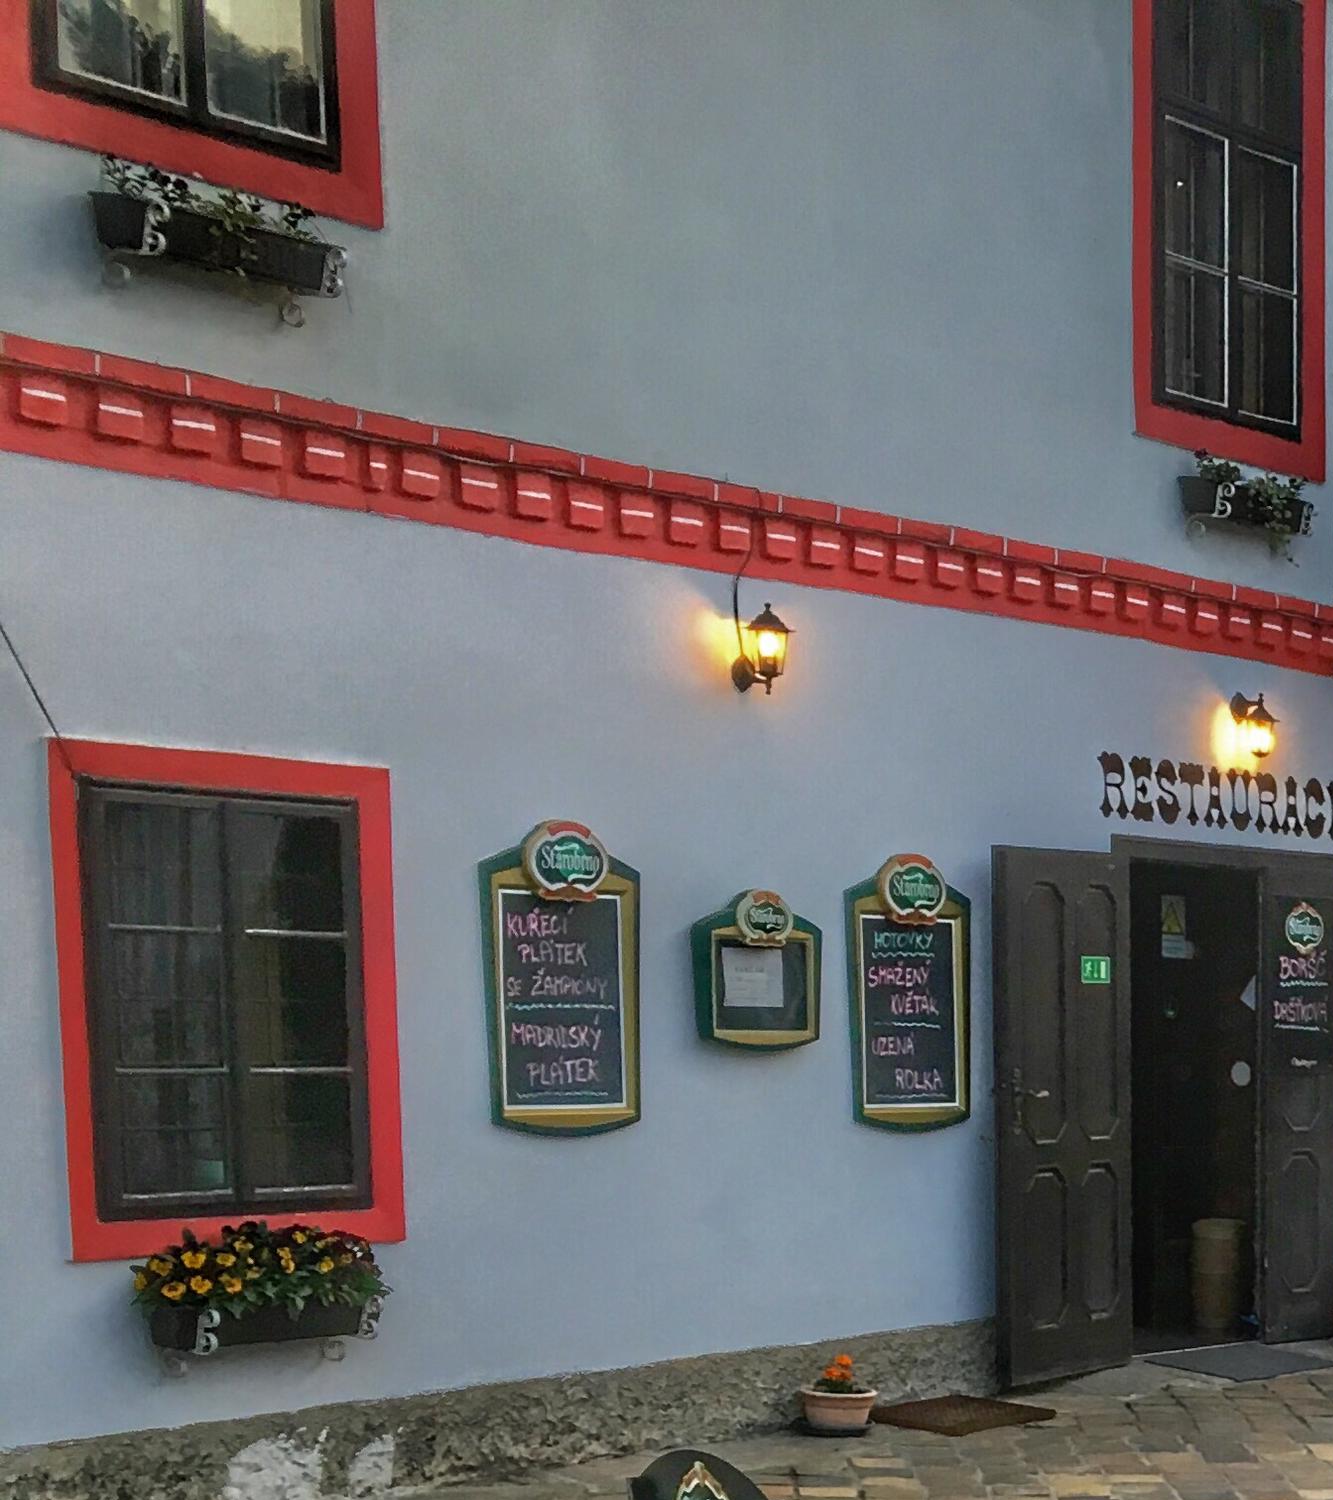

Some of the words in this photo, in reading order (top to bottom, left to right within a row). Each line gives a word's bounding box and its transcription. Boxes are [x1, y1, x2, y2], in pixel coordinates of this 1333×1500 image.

[541, 841, 600, 882] Starobrno
[506, 907, 574, 939] KUŘECÍ
[517, 939, 588, 967] PLÁTEK
[507, 976, 522, 997] SE
[526, 1056, 600, 1087] PLÁTEK
[895, 1067, 943, 1091] ROLKA
